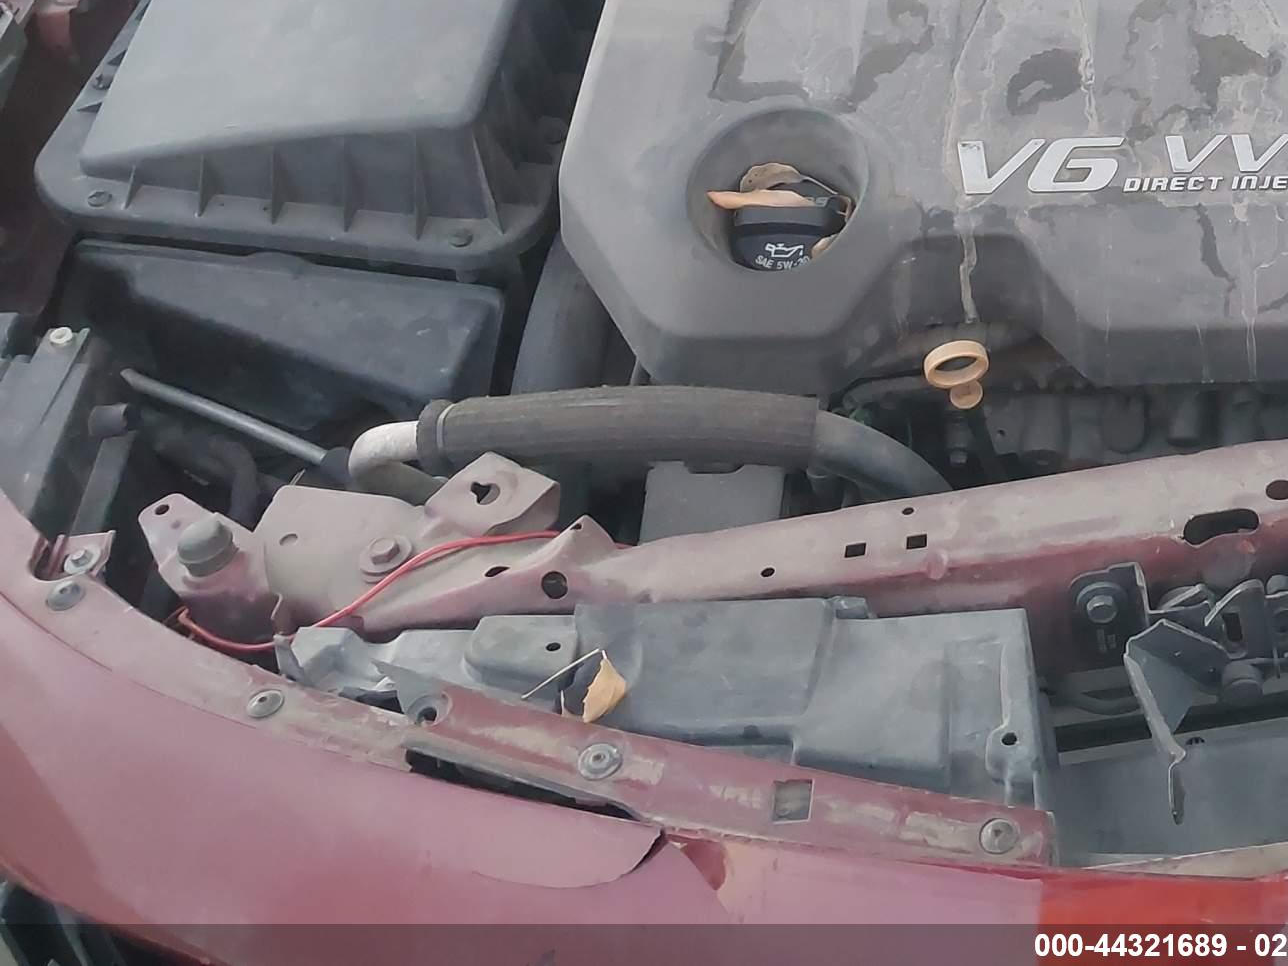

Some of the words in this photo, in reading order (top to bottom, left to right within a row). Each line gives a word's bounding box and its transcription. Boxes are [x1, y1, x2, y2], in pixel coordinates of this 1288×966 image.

[957, 137, 1126, 194] V6
[1123, 176, 1224, 192] DIRECT
[755, 255, 775, 269] SAE
